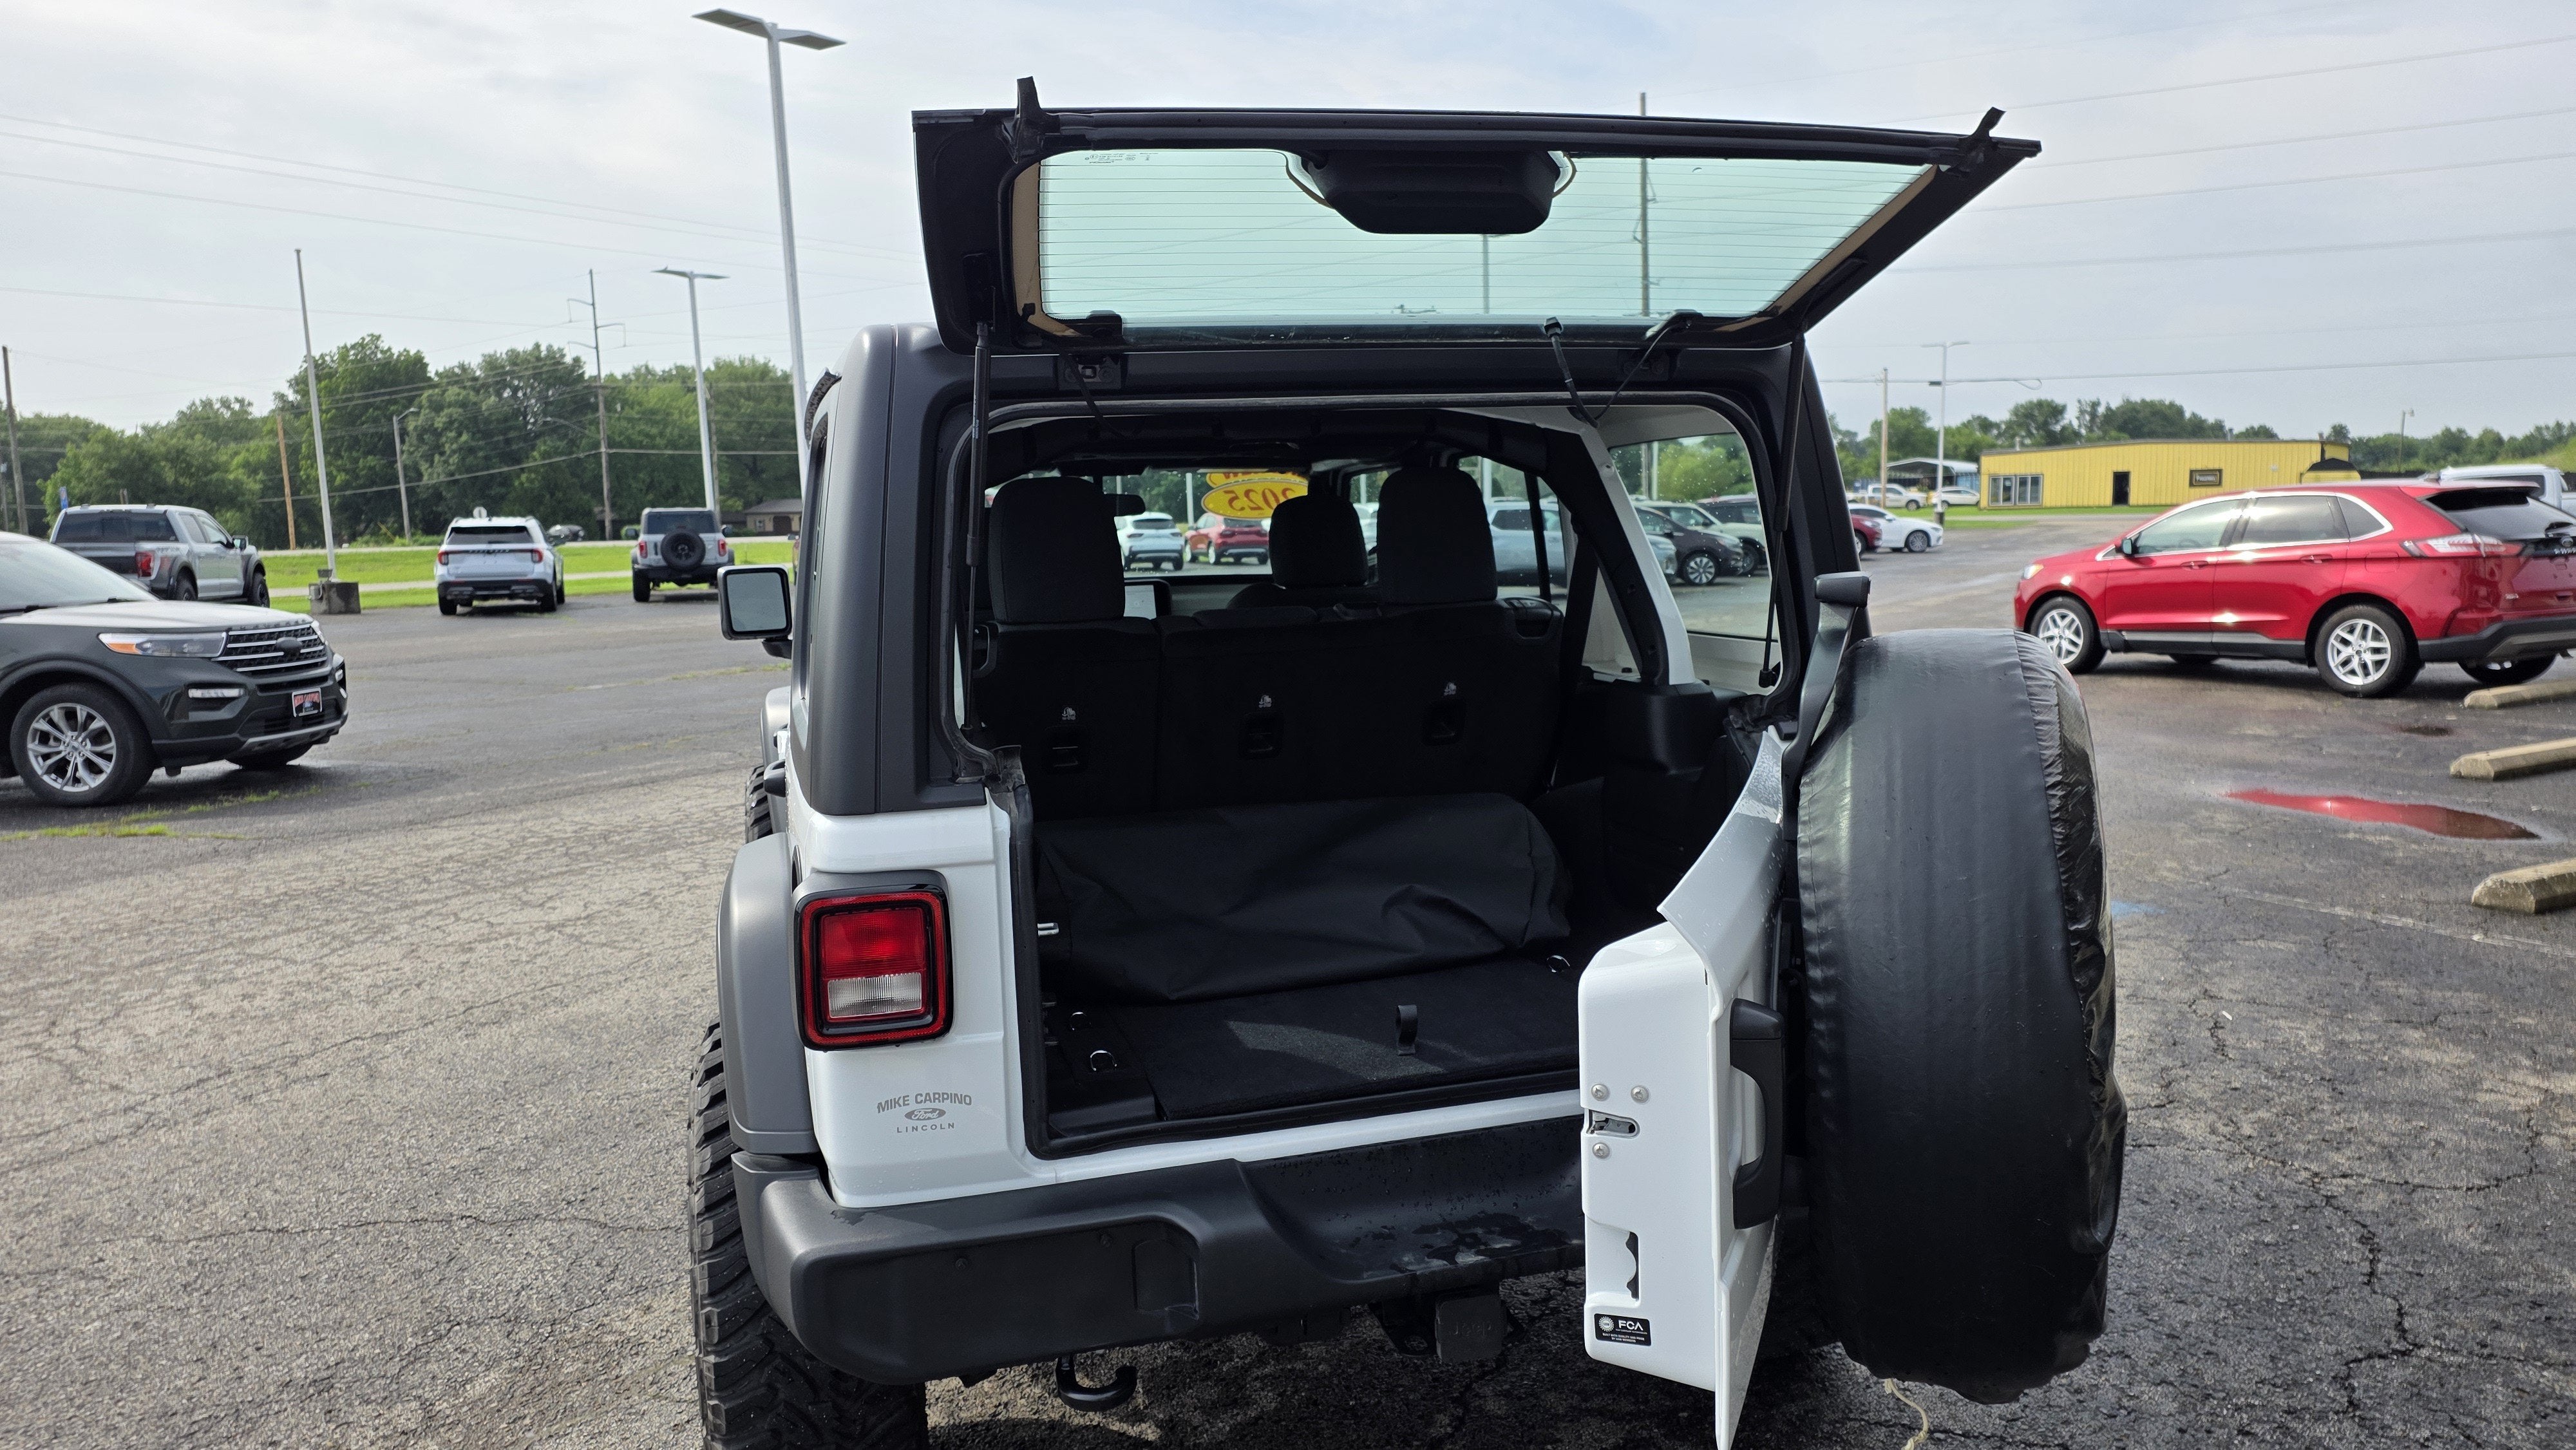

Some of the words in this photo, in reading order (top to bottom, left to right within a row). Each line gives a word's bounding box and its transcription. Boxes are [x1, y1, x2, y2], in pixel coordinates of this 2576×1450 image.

[876, 1095, 910, 1113] MIKE
[914, 1092, 972, 1106] CARPINO
[911, 1109, 939, 1119] Ford
[896, 1122, 955, 1133] LINCOLN
[1618, 1320, 1643, 1331] FCA
